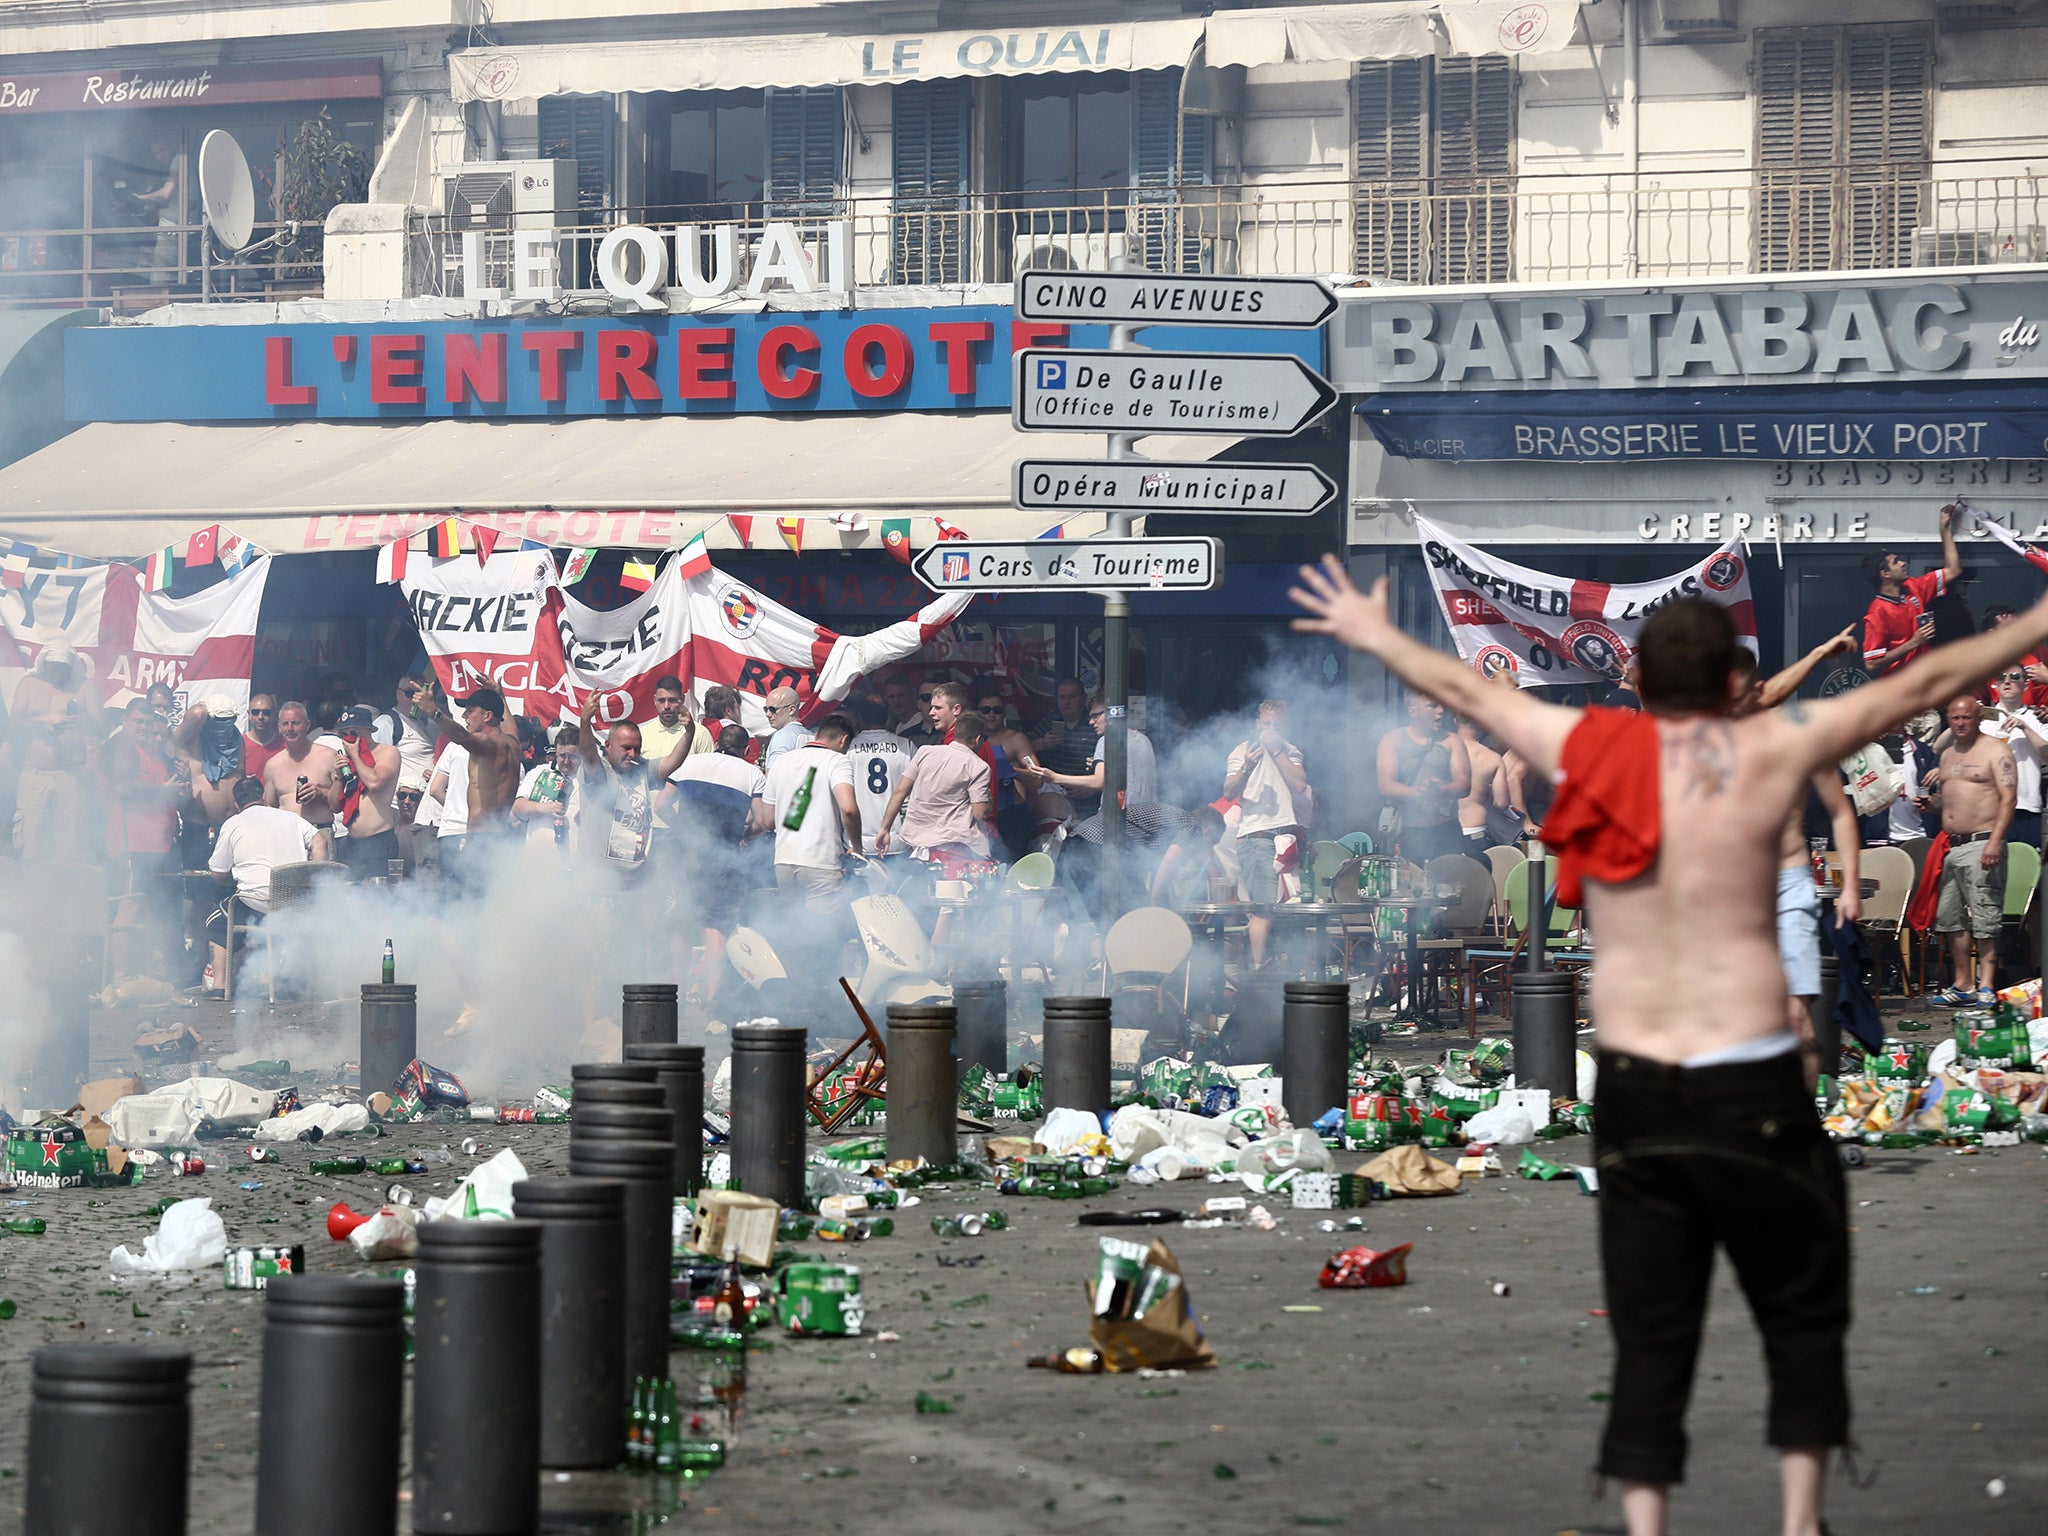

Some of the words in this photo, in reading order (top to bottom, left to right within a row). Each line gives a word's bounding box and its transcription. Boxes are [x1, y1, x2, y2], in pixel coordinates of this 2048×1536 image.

[862, 39, 923, 77] LE
[957, 28, 1110, 75] QUAI
[1, 82, 40, 107] Bar
[83, 70, 211, 104] Restaurant
[536, 178, 549, 187] LG
[463, 230, 562, 300] LE
[597, 221, 852, 311] QUAI
[1036, 284, 1107, 308] CINQ
[1131, 288, 1264, 313] AVENUES
[1370, 297, 1598, 382] BAR
[1604, 283, 1970, 377] TABAC
[1998, 315, 2039, 347] du
[1076, 366, 1111, 389] De
[1130, 367, 1223, 391] Gaulle
[1035, 394, 1114, 416] (Office
[1128, 398, 1153, 416] de
[1170, 400, 1279, 421] Tourisme)
[1514, 424, 1700, 457] BRASSERIE
[1719, 423, 1758, 453] LE
[1773, 423, 1875, 455] VIEUX
[1894, 422, 1988, 455] PORT
[1773, 460, 2043, 486] BRASSERIE
[1033, 473, 1117, 501] Opéra
[1139, 476, 1286, 506] Municipal
[1638, 512, 1868, 539] CREPERIE
[979, 555, 1033, 577] Cars
[1093, 553, 1200, 576] Tourisme
[449, 658, 635, 723] ENGLAD
[854, 742, 898, 754] LAMPARD
[867, 757, 889, 795] 8
[16, 1169, 83, 1188] Heineken
